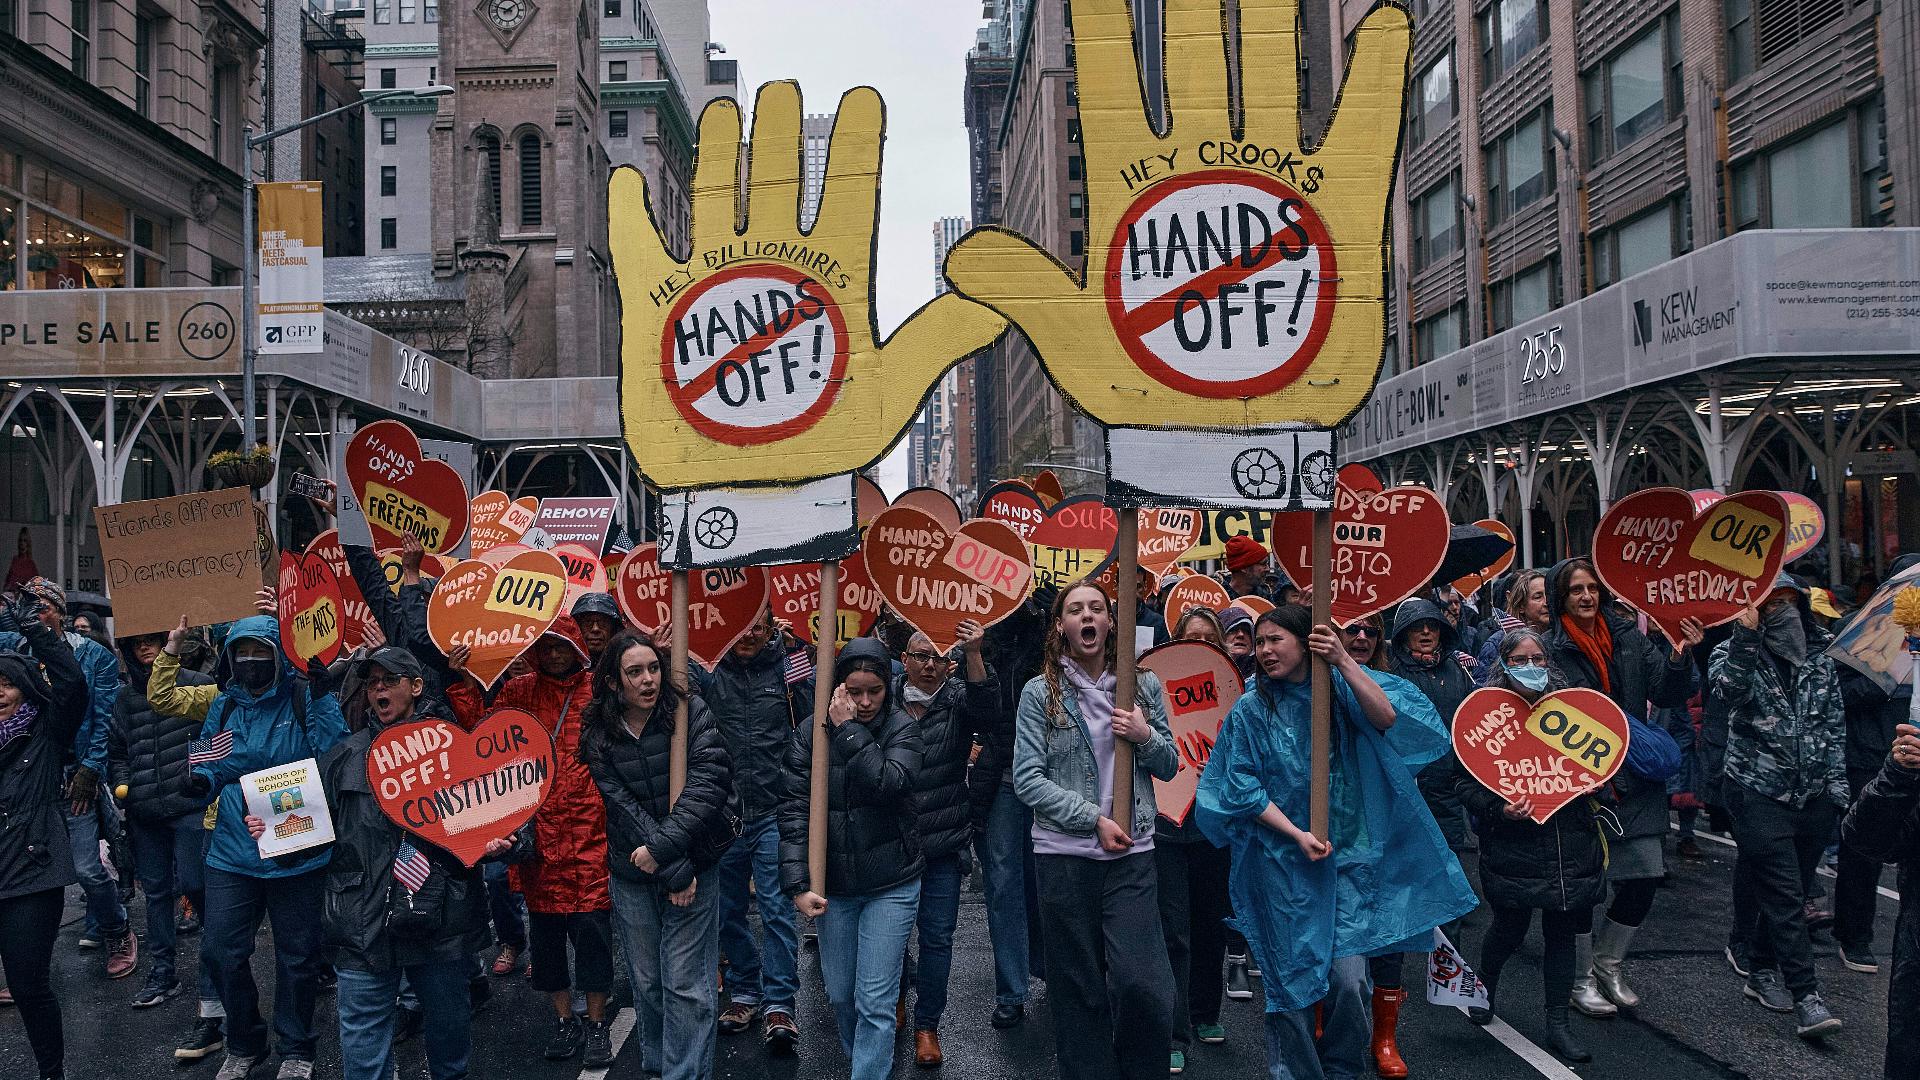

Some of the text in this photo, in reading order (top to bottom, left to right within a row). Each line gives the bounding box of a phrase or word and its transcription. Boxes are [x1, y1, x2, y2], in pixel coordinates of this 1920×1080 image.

[1120, 141, 1324, 196] HEY CROOK$
[261, 231, 287, 240] WHERE
[1127, 198, 1309, 281] HANDS
[262, 249, 285, 257] MEETS
[649, 240, 851, 307] HEY BILLIONAIRES
[1173, 268, 1311, 353] OFF!
[1660, 286, 1698, 327] KEW
[1847, 308, 1869, 319] (212)
[76, 321, 160, 344] SALE
[186, 322, 228, 340] 260
[286, 325, 317, 338] GFP
[673, 278, 826, 366] HANDS
[1661, 307, 1736, 345] MANAGEMENT
[715, 324, 825, 408] OFF!
[1521, 324, 1565, 384] 255
[398, 348, 430, 396] 260
[1519, 386, 1538, 407] Fifth
[1540, 383, 1571, 401] Avenue
[365, 434, 416, 477] HANDS
[368, 456, 406, 483] OFF!
[102, 504, 176, 539] Hands
[178, 498, 208, 527] Off
[385, 492, 428, 521] OUR
[471, 500, 530, 529] HANDS OUR
[473, 512, 499, 524] OFF!
[541, 507, 610, 519] REMOVE
[991, 499, 1043, 524] HANDS
[1057, 507, 1119, 531] OUR
[1371, 494, 1425, 515] OFF
[369, 496, 440, 549] FREEDOMS
[471, 526, 509, 542] PUBLIC
[1001, 519, 1037, 537] FF!
[1159, 511, 1192, 531] OUR
[1201, 511, 1272, 546] ICH
[1335, 524, 1382, 542] OUR
[1613, 515, 1685, 542] HANDS
[471, 540, 495, 550] EDIA
[551, 533, 600, 541] RRUPTION
[879, 526, 945, 550] HANDS
[1137, 535, 1192, 557] ACCINES
[1622, 514, 1771, 569] OFF! OUR
[108, 541, 262, 590] Democracy!
[888, 541, 1019, 592] OFF! OUR
[1033, 544, 1093, 573] LTH-
[302, 563, 328, 590] OUR
[438, 566, 488, 596] HANDS
[705, 566, 746, 592] OUR
[772, 559, 848, 596] HANS
[1330, 574, 1378, 604] ghts
[1645, 569, 1758, 606] FREEDOMS
[445, 575, 550, 611] OFF! OUR
[843, 582, 884, 617] OUR
[896, 574, 994, 615] UNIONS
[1176, 587, 1223, 606] HANDS
[295, 602, 336, 641] THE ARTS
[656, 601, 727, 630] DTA
[1174, 680, 1218, 707] OUR
[1463, 702, 1516, 748] HANDS
[1485, 710, 1611, 769] OFF! OUR
[372, 723, 453, 775] HANDS
[380, 724, 529, 800] OFF! OUR
[290, 767, 308, 777] OFF
[1494, 755, 1574, 777] PUBLIC
[402, 755, 548, 828] CONSTITUTION
[1498, 773, 1597, 796] SCHOOLS
